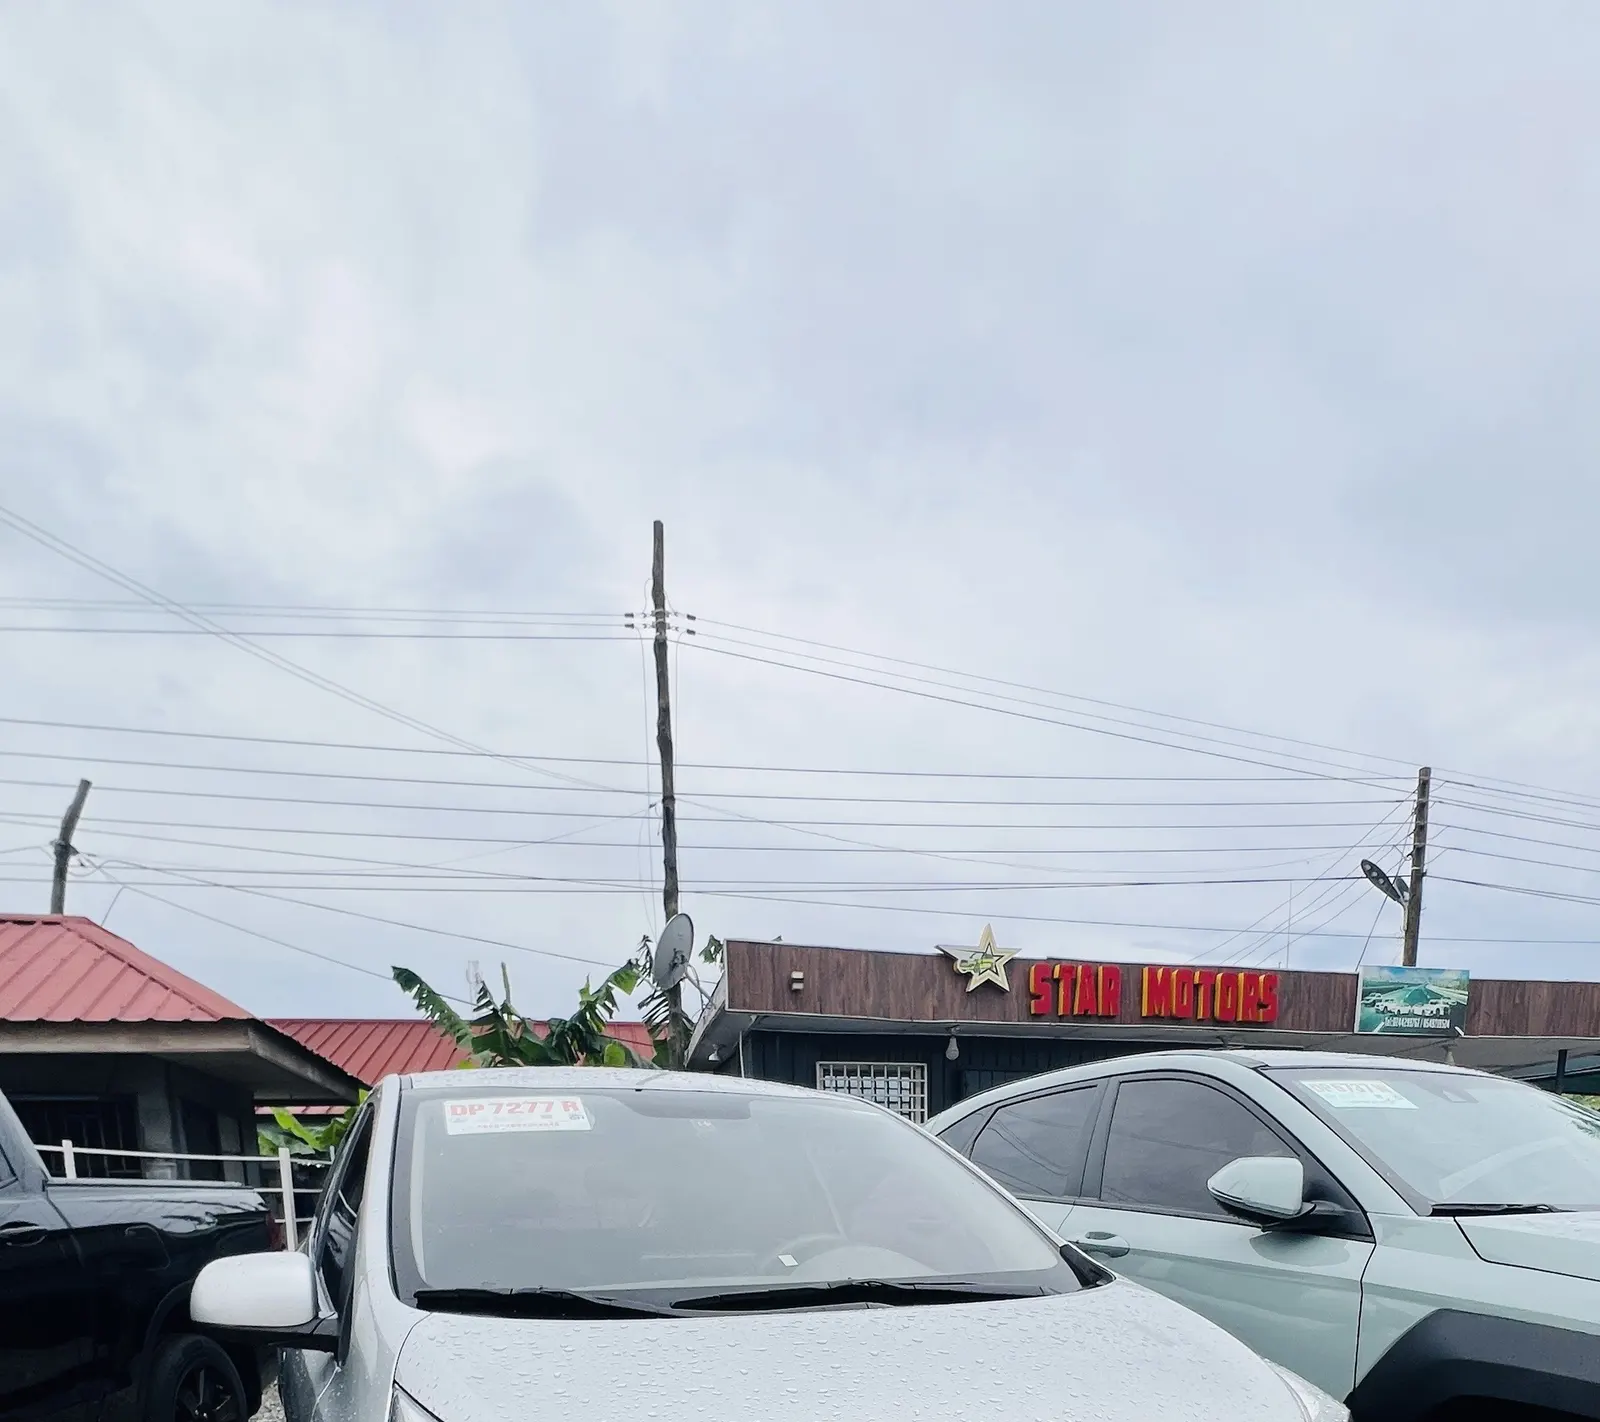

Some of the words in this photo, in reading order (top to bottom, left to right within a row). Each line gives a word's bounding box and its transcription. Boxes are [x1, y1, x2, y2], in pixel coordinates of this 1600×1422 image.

[1030, 963, 1122, 1017] STAR
[1142, 966, 1279, 1023] MOTORS
[449, 1103, 485, 1117] DP
[488, 1100, 555, 1115] 7277
[562, 1100, 580, 1112] R
